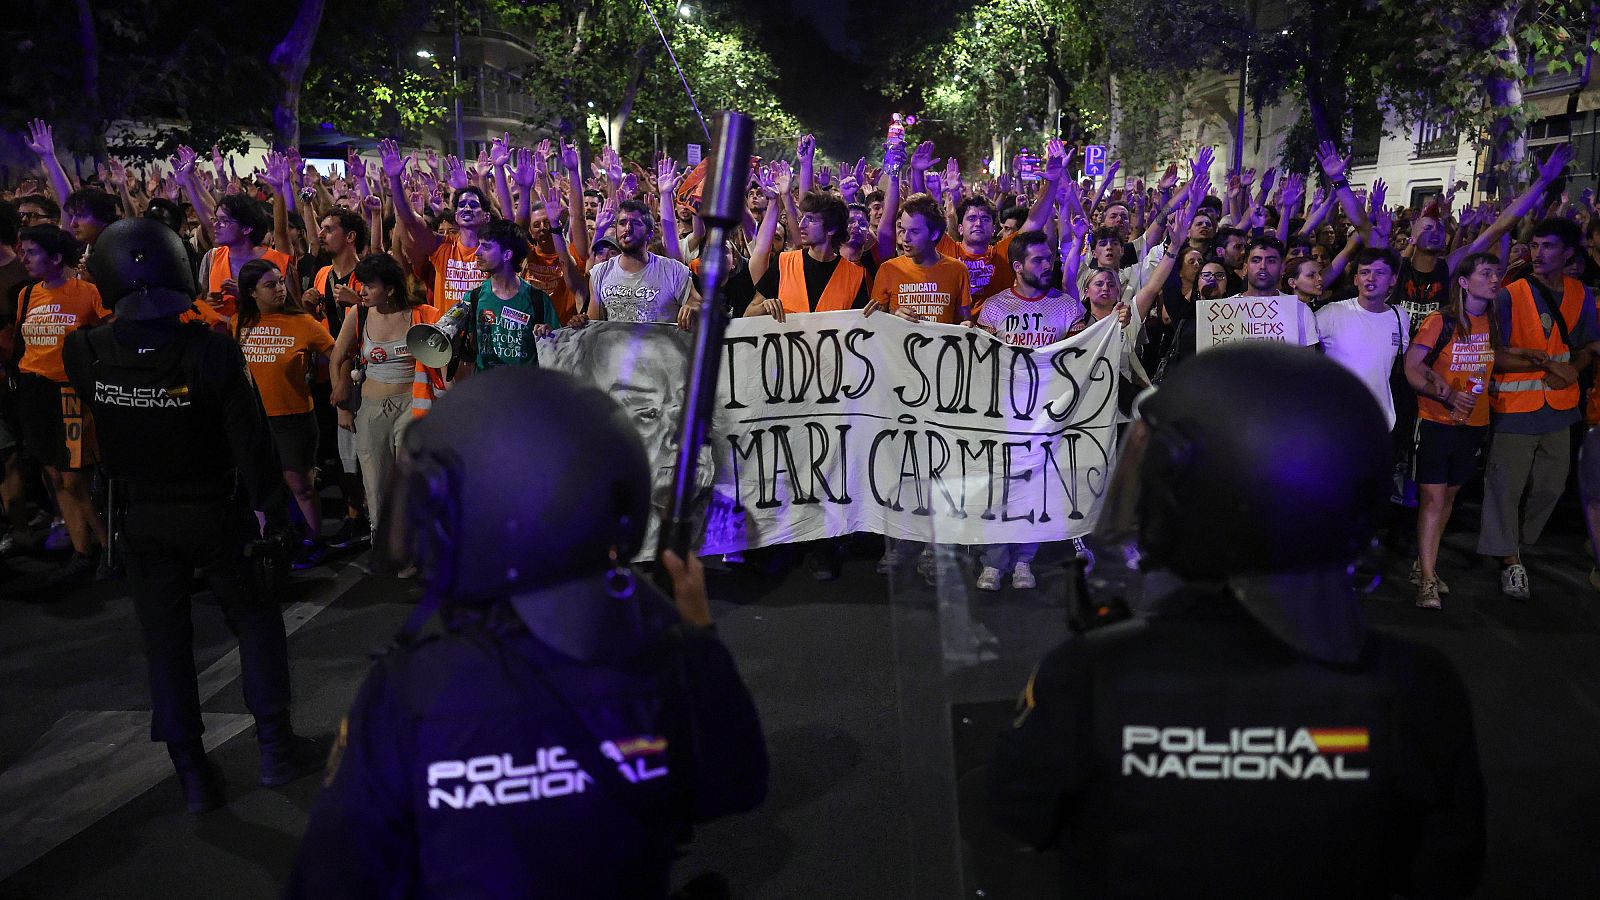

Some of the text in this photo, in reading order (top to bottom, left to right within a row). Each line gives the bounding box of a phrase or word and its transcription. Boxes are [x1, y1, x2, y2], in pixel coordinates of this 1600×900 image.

[1089, 147, 1102, 166] P
[445, 291, 452, 299] DE
[899, 282, 938, 293] SINDICATO
[899, 294, 950, 304] DE INQUILINAS
[1207, 299, 1279, 323] SOMOS
[1006, 312, 1043, 332] MST
[1211, 321, 1284, 336] LXS NIETXS
[31, 336, 58, 345] MADRID
[721, 327, 1088, 422] TODOS SOMOS
[95, 381, 169, 398] POLICIA
[95, 391, 191, 408] NACIONAL
[726, 421, 1082, 524] MARI CARMEN
[1121, 725, 1320, 753] POLICIA
[1121, 753, 1371, 780] NACIONAL
